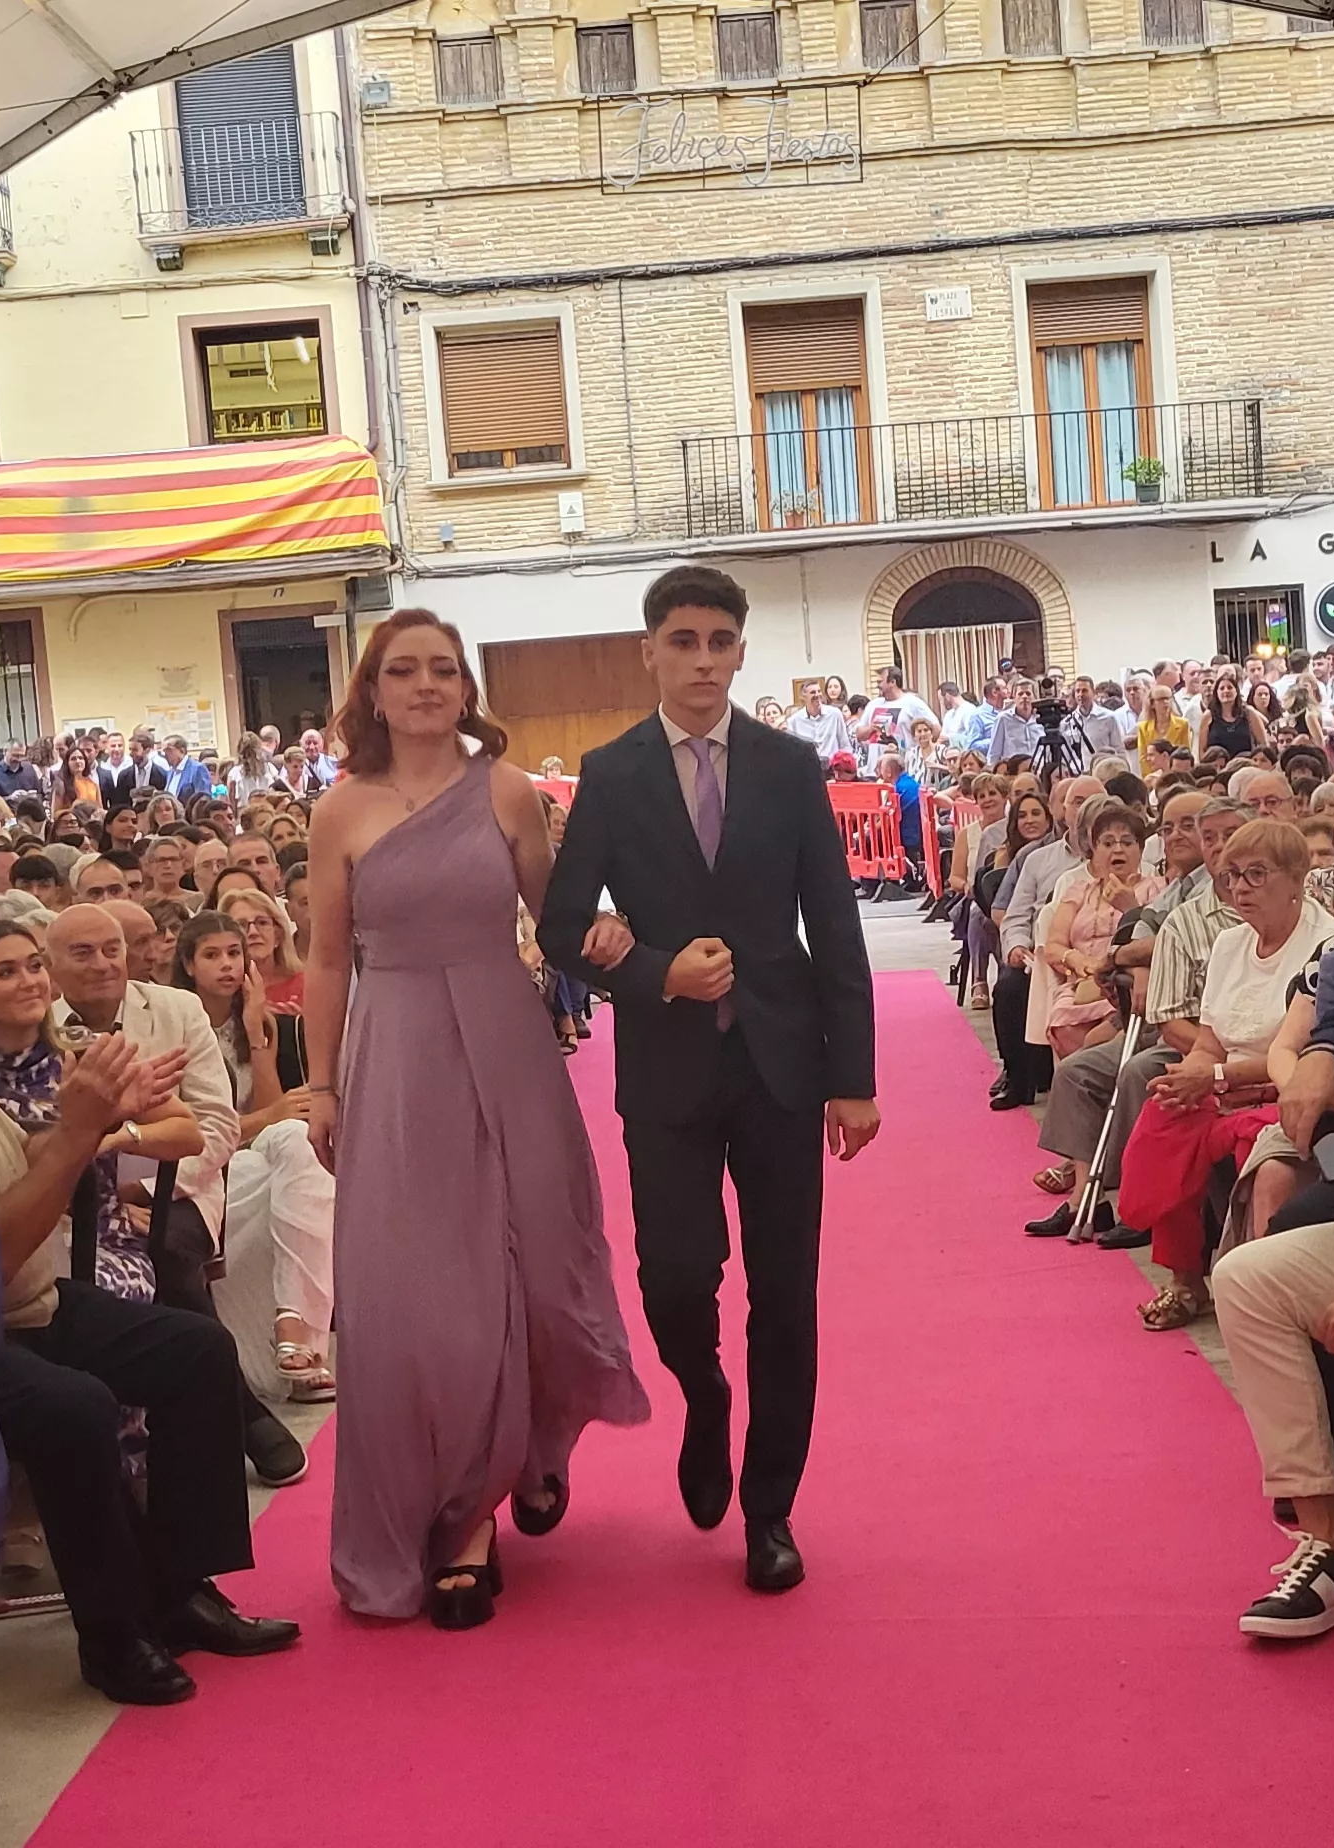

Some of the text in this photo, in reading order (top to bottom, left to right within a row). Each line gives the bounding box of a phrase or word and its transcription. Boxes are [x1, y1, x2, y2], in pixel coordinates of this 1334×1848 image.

[605, 95, 860, 187] Felices Fiestas
[939, 291, 957, 300] PLAZA
[1210, 538, 1267, 563] LA
